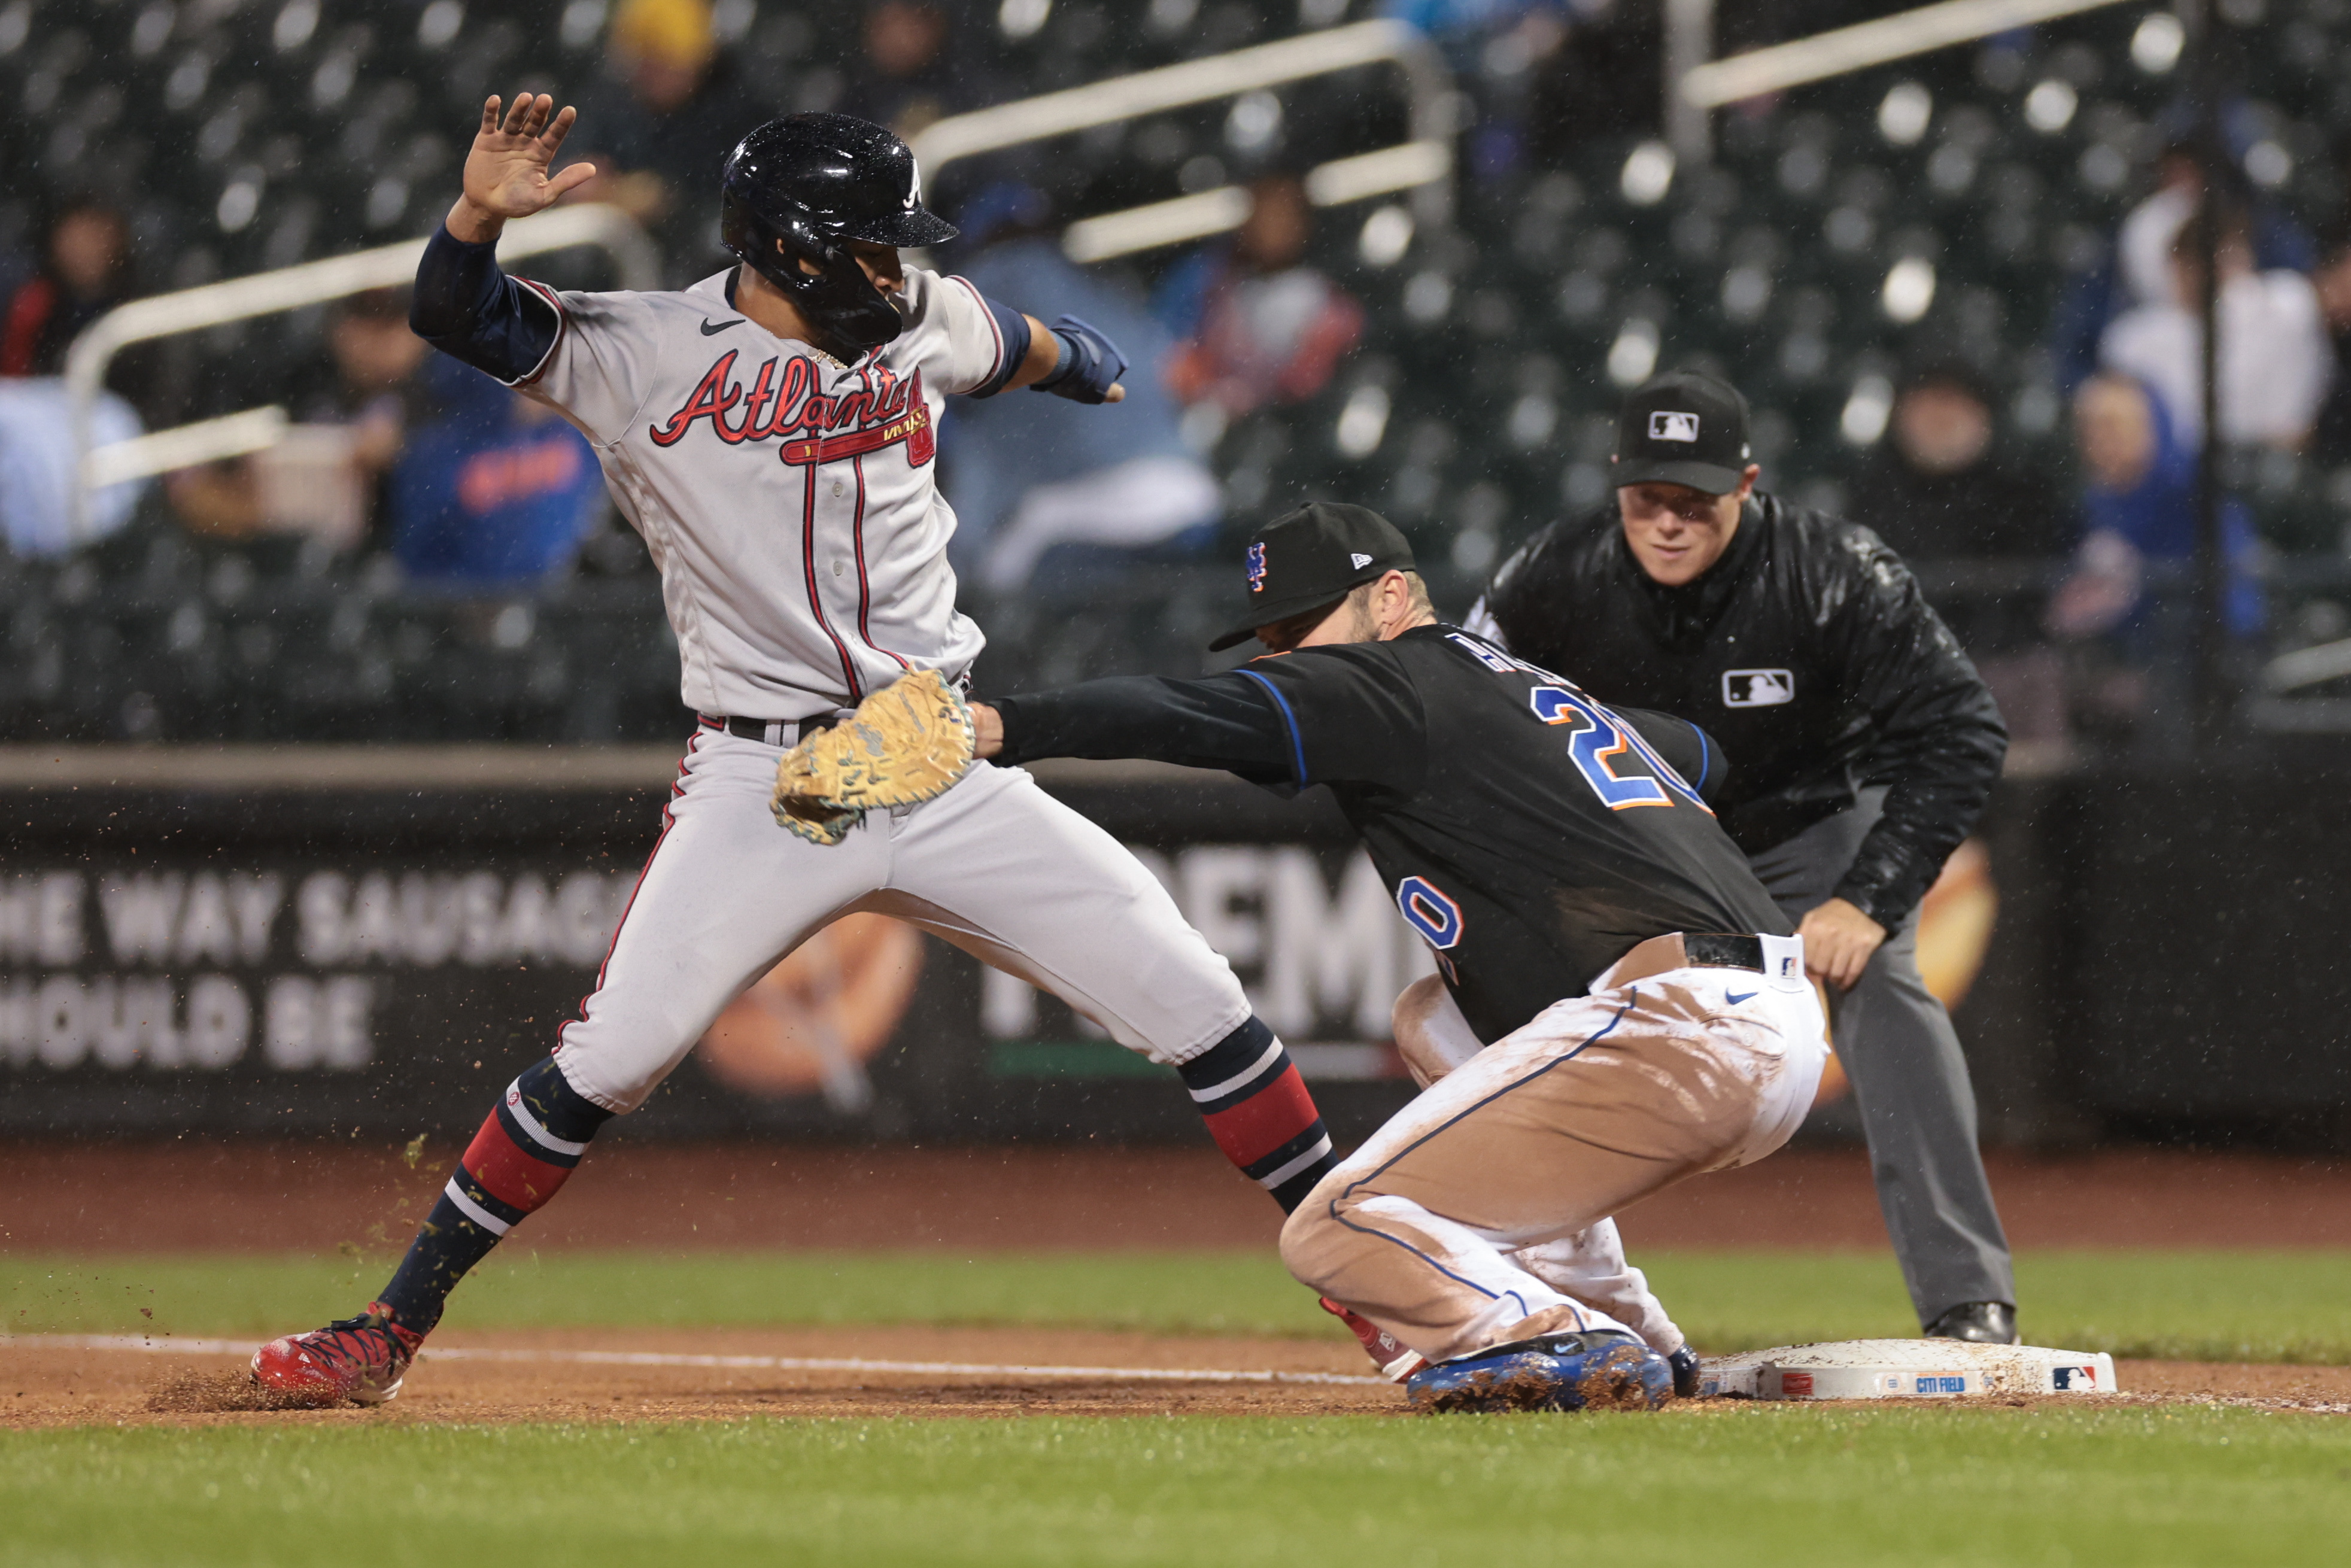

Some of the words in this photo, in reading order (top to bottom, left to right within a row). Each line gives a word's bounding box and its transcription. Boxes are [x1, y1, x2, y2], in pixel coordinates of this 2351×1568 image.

[649, 348, 910, 448] Atlanta
[99, 871, 283, 965] WAY
[265, 973, 374, 1070] BE
[1916, 1378, 1937, 1393] CITI
[1940, 1376, 1965, 1393] FIELD
